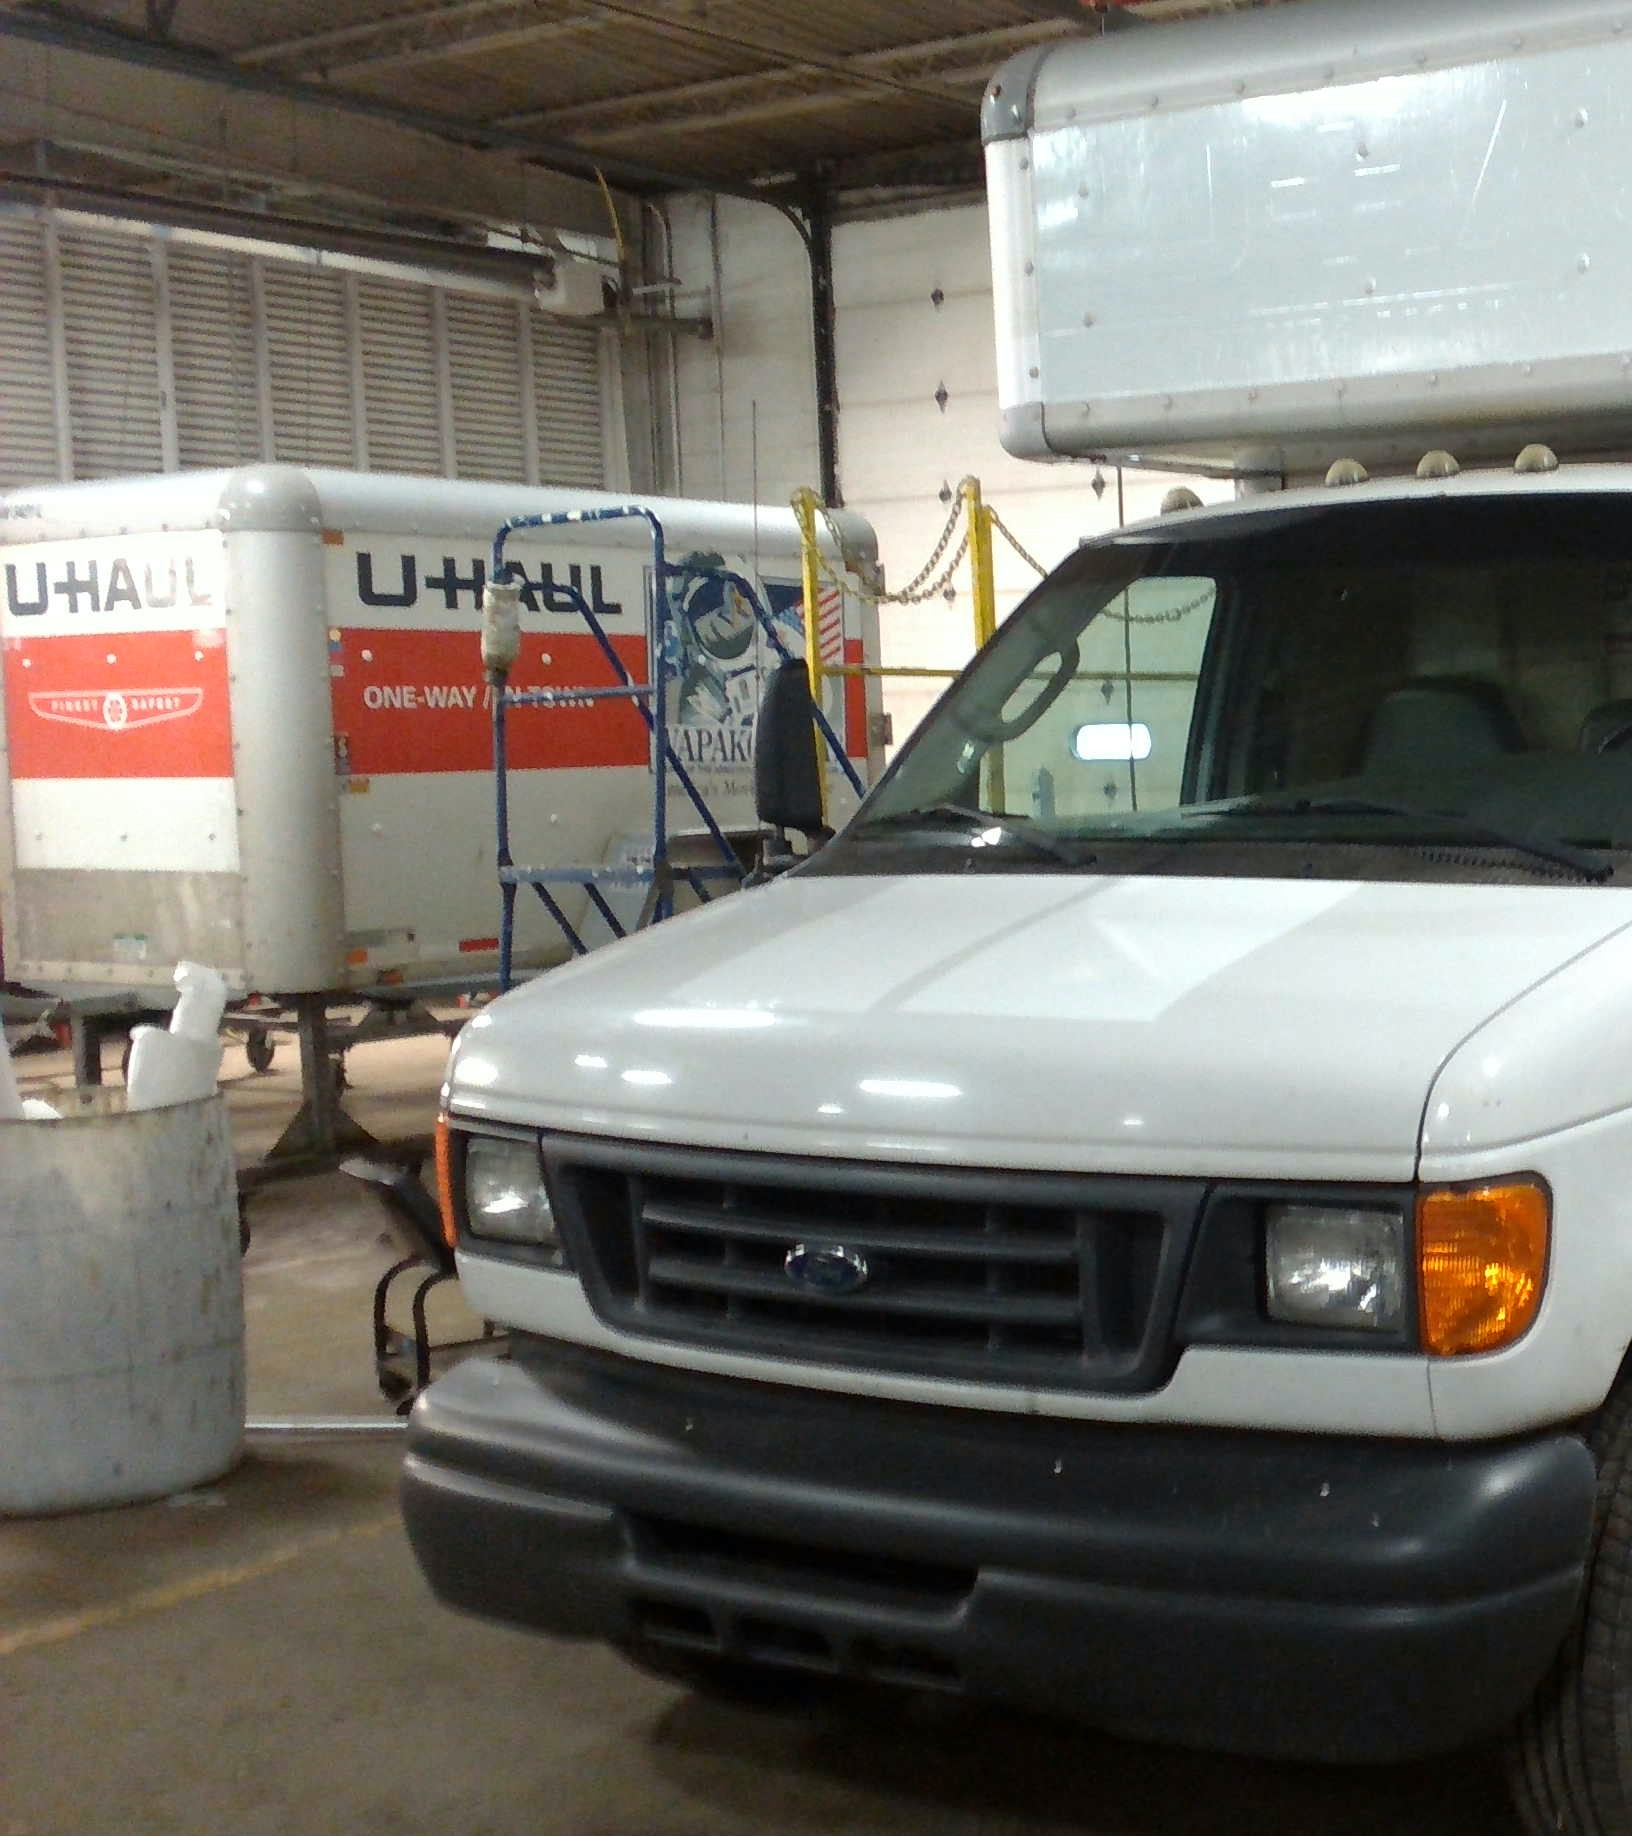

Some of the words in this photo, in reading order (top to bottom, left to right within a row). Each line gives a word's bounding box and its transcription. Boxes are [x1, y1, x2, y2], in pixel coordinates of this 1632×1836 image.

[4, 556, 213, 616] U-HAUL
[356, 551, 623, 615] U-HAUL
[363, 684, 477, 709] ONE-WAY
